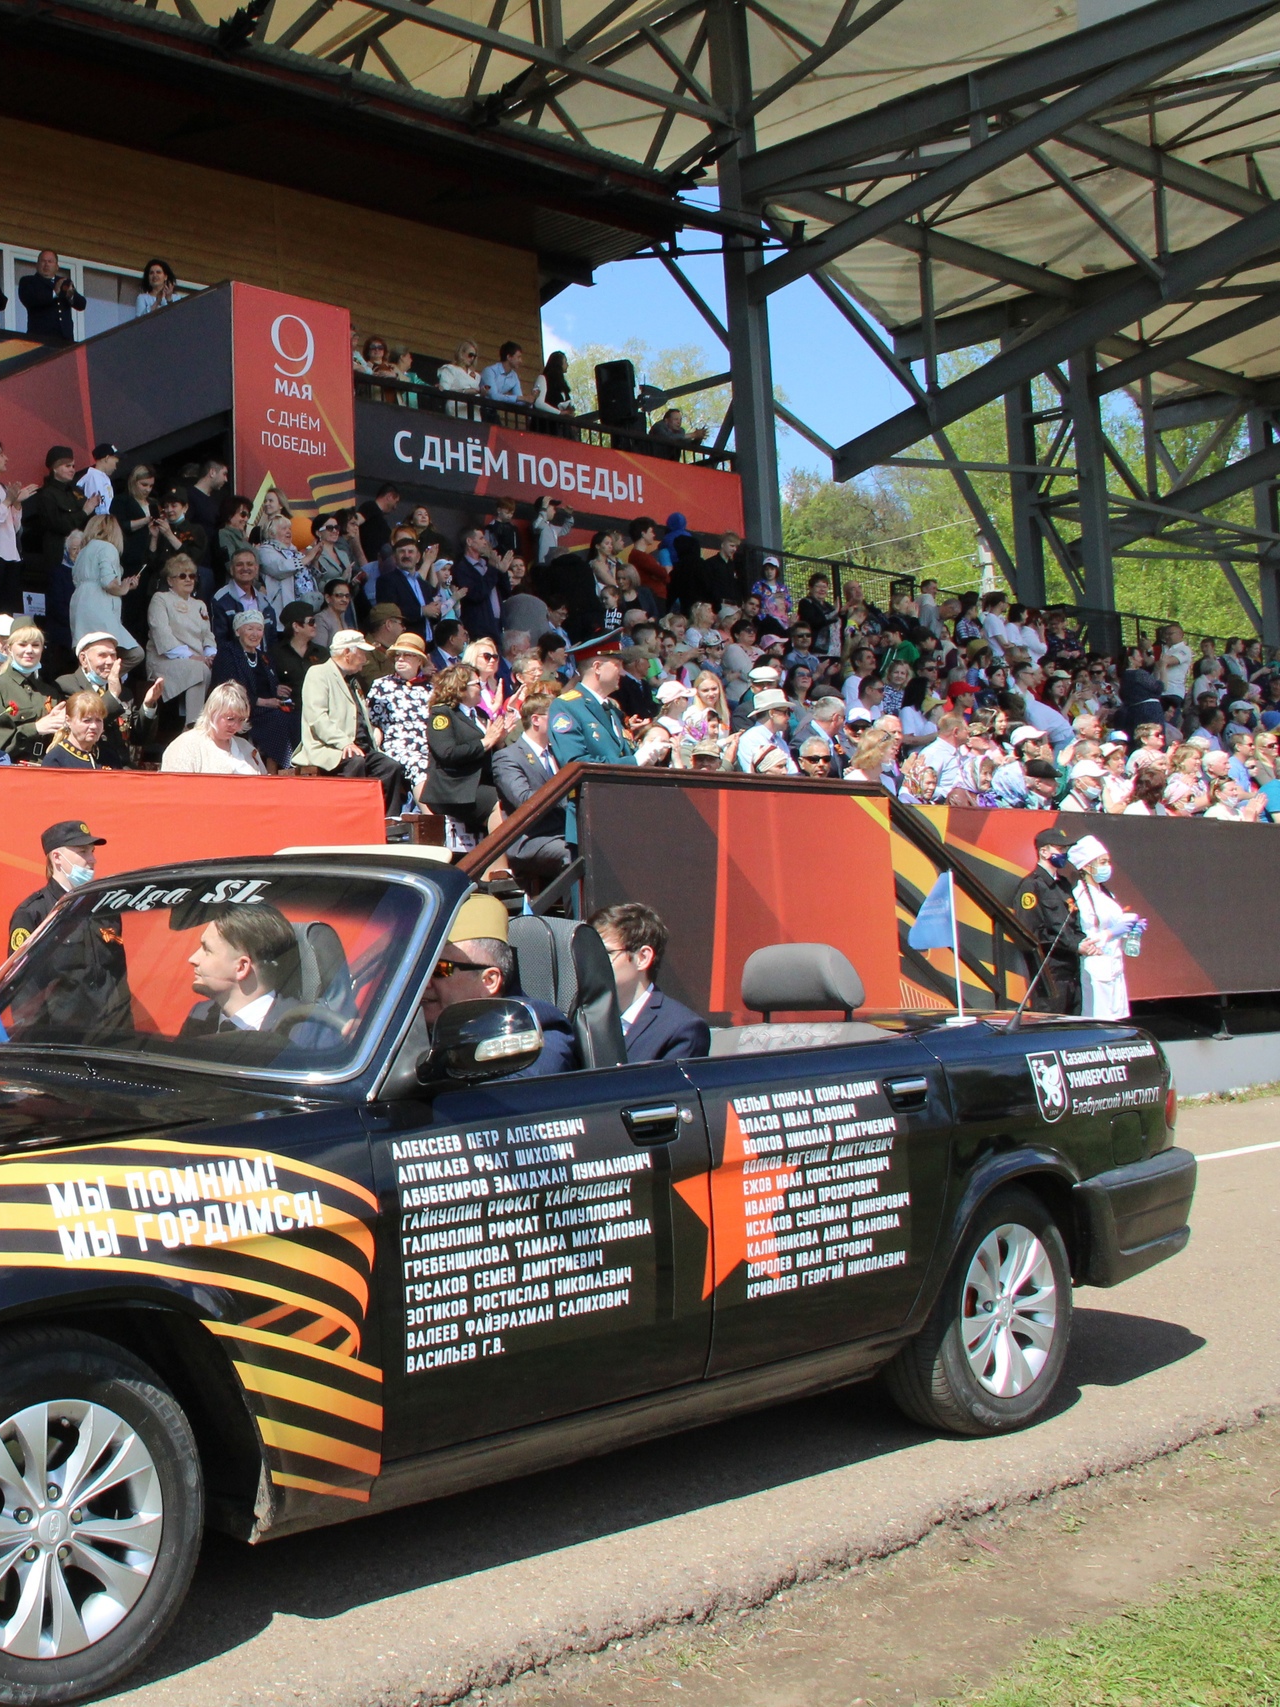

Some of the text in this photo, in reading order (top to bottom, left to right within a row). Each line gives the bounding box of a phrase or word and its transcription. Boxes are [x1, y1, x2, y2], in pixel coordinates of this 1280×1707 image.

[270, 314, 315, 377] 9
[274, 378, 313, 401] МАЯ
[266, 408, 320, 432] С ДНЁМ
[261, 431, 327, 457] ПОБЕДЫ!
[393, 430, 645, 504] С ДНЁМ ПОБЕДЫ!
[91, 884, 192, 913] Volga
[1059, 1042, 1156, 1066] Казанский федеральный
[733, 1080, 878, 1114] ВЕЛЬШ КОНРАД КОНРАДОВИЧ
[1066, 1065, 1128, 1089] УНИВЕРСИТЕТ
[738, 1103, 857, 1134] ВЛАСОВ ИВАН ЛЬВОВИЧ
[1072, 1086, 1160, 1116] Елабужский ИНСТИТУТ
[392, 1118, 585, 1160] АЛЕКСЕЕВ ПЕТР АЛЕКСЕЕВИЧ
[742, 1117, 896, 1154] ВОЛКОВ НИКОЛАЙ ДМИТРИЕВИЧ
[743, 1136, 894, 1175] ВОЛКОВ ЕВГЕНИЙ ДМИТРИЕВИЧ
[398, 1141, 575, 1184] АПТИКАЕВ ФУАТ ШИХОВИЧ
[403, 1152, 651, 1208] АБУБЕКИРОВ ЗАКИДЖАН ЛУКМАНОВИЧ
[743, 1156, 890, 1196] ЕЖОВ ИВАН КОНСТАНТИНОВИЧ
[46, 1155, 279, 1219] МЫ ПОМНИМ!
[402, 1178, 632, 1231] ГАЙНУЛЛИН РИФКАТ ХАЙРУЛЛОВИЧ
[745, 1178, 878, 1216] ИВАНОВ ИВАН ПРОХОРОВИЧ
[57, 1190, 324, 1262] МЫ ГОРДИМСЯ!
[402, 1199, 632, 1255] ГАЛИУЛЛИН РИФКАТ ГАЛИУЛЛОВИЧ
[746, 1191, 910, 1237] ИСХАКОВ СУЛЕЙМАН ДИННУРОВИЧ
[404, 1218, 652, 1280] ГРЕБЕНЩИКОВА ТАМАРА МИХАЙЛОВНА
[747, 1213, 900, 1258] КАЛИННИКОВА АННА ИВАНОВНА
[405, 1249, 603, 1303] ГУСАКОВ СЕМЕН ДМИТРИЕВИЧ
[747, 1238, 873, 1279] КОРОЛЕВ ИВАН ПЕТРОВИЧ
[747, 1250, 906, 1299] КРИВИЛЕВ ГЕОРГИЙ НИКОЛАЕВИЧ
[406, 1266, 632, 1326] ЗОТИКОВ РОСТИСЛАВ НИКОЛАЕВИЧ
[406, 1288, 629, 1350] ВАЛЕЕВ ФАЙЗРАХМАН САЛИХОВИЧ
[406, 1337, 506, 1373] ВАСИЛЬЕВ Г.В.
